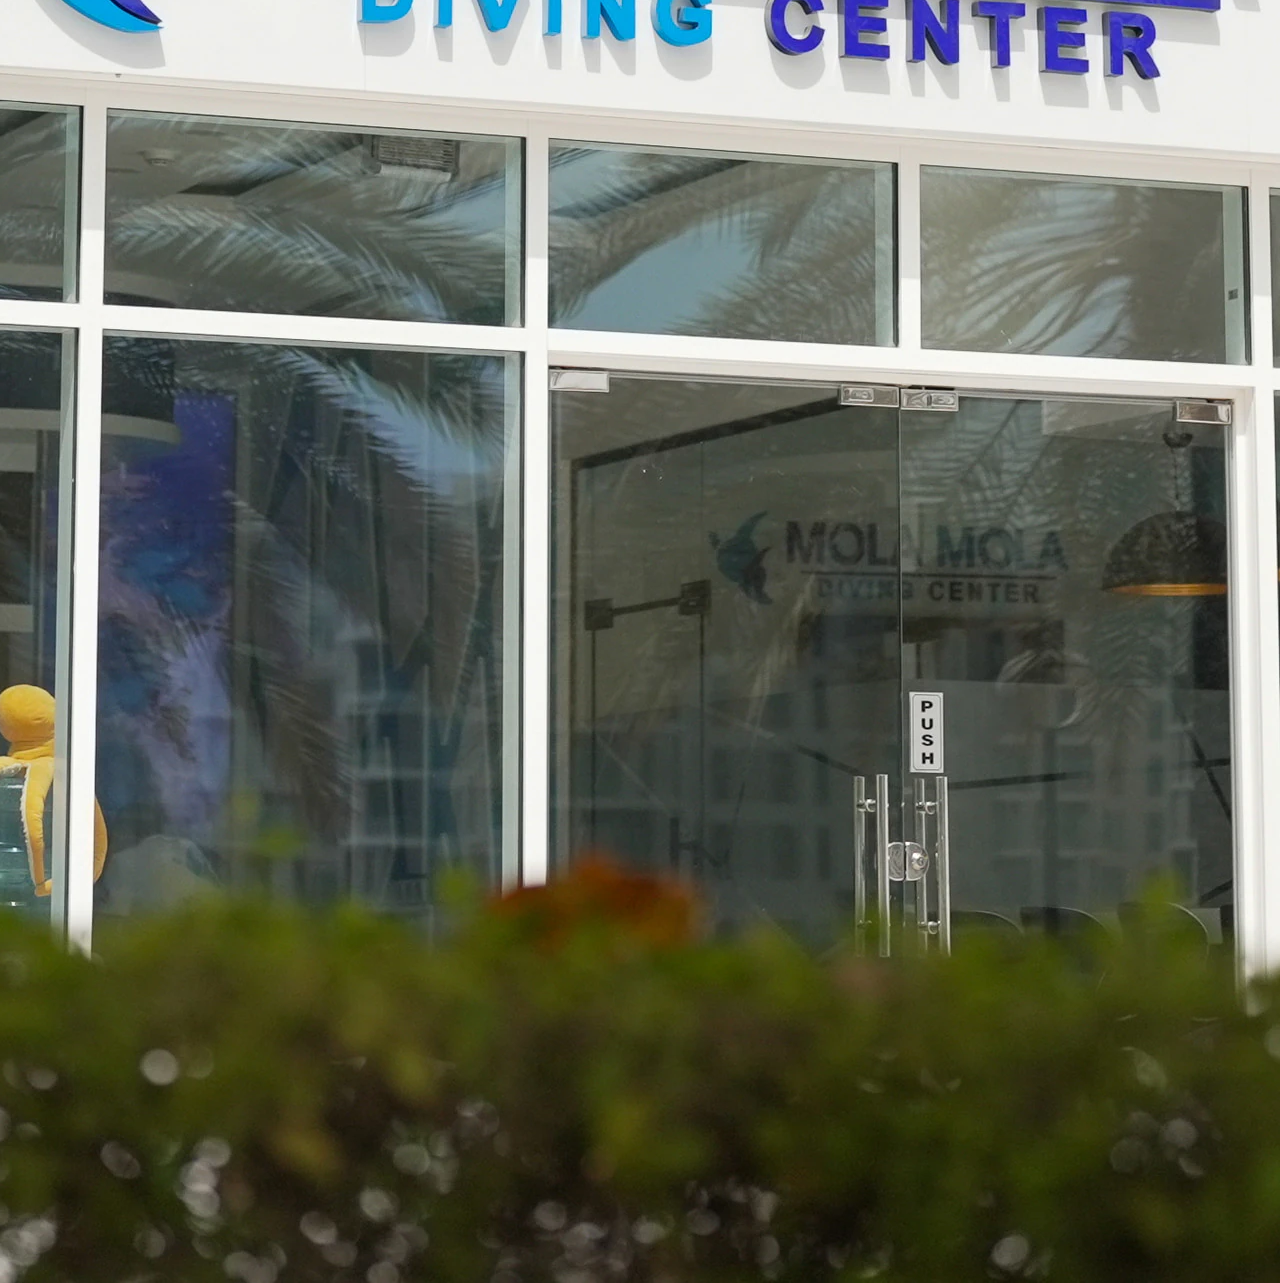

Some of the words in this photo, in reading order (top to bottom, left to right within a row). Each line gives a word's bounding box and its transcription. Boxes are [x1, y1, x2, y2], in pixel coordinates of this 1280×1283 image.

[935, 523, 1069, 572] MOLA
[927, 580, 1040, 604] CENTER
[920, 700, 935, 765] PUSH
